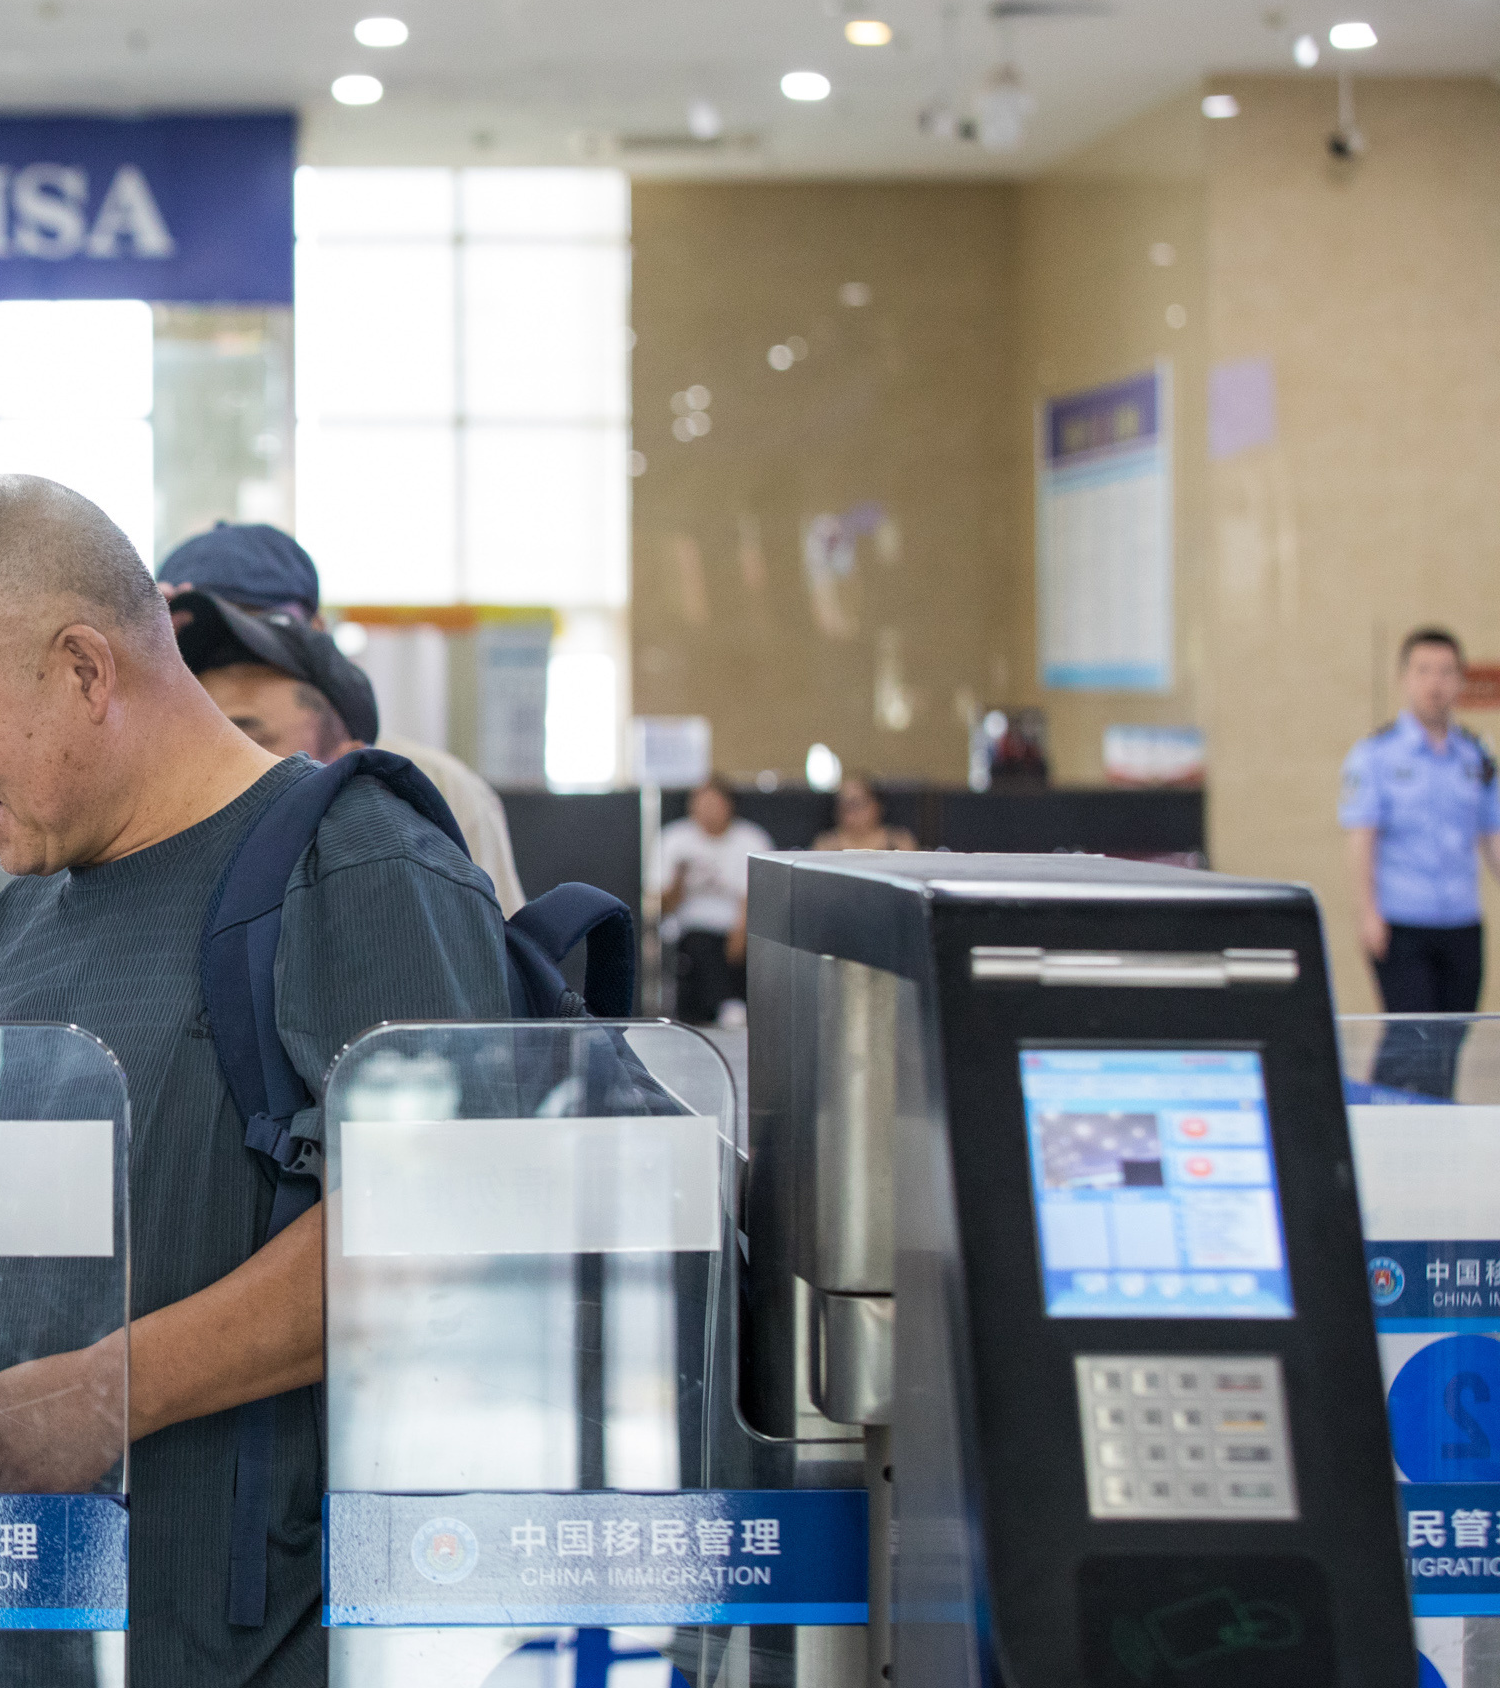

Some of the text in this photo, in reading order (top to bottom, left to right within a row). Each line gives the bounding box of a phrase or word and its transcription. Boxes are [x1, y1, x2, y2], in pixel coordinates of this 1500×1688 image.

[1433, 1291, 1482, 1307] CHINA
[510, 1518, 782, 1558] 中国移民管理
[1407, 1508, 1500, 1548] 民管
[521, 1567, 771, 1587] CHINA IMMIGRATION
[1404, 1556, 1500, 1577] IGRATIO
